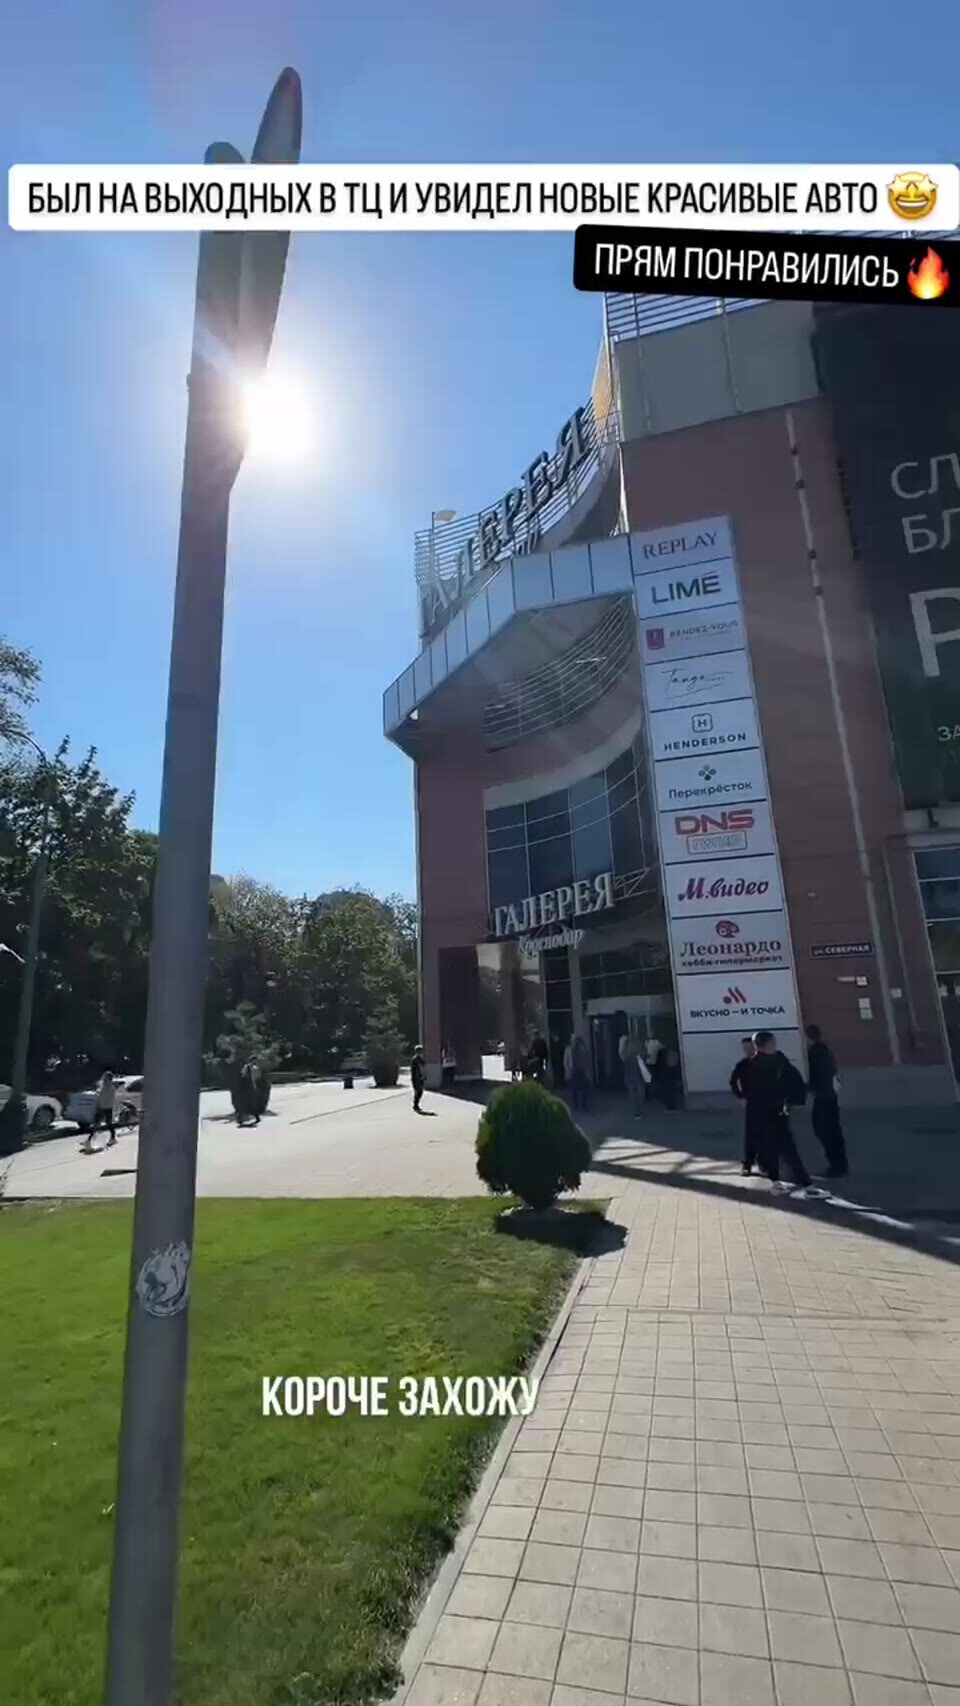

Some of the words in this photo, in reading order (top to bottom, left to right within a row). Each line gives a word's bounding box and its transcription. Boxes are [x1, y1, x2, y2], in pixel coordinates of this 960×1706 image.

[643, 531, 717, 559] REPLAY
[664, 733, 746, 752] HENDERSON
[675, 809, 756, 835] DNS
[678, 877, 769, 901] М.видео
[495, 872, 616, 937] ГАЛЕРЕЯ
[680, 940, 782, 957] Леонардо
[690, 1009, 730, 1018] ВКУСНО
[750, 1006, 785, 1015] ТОЧКА
